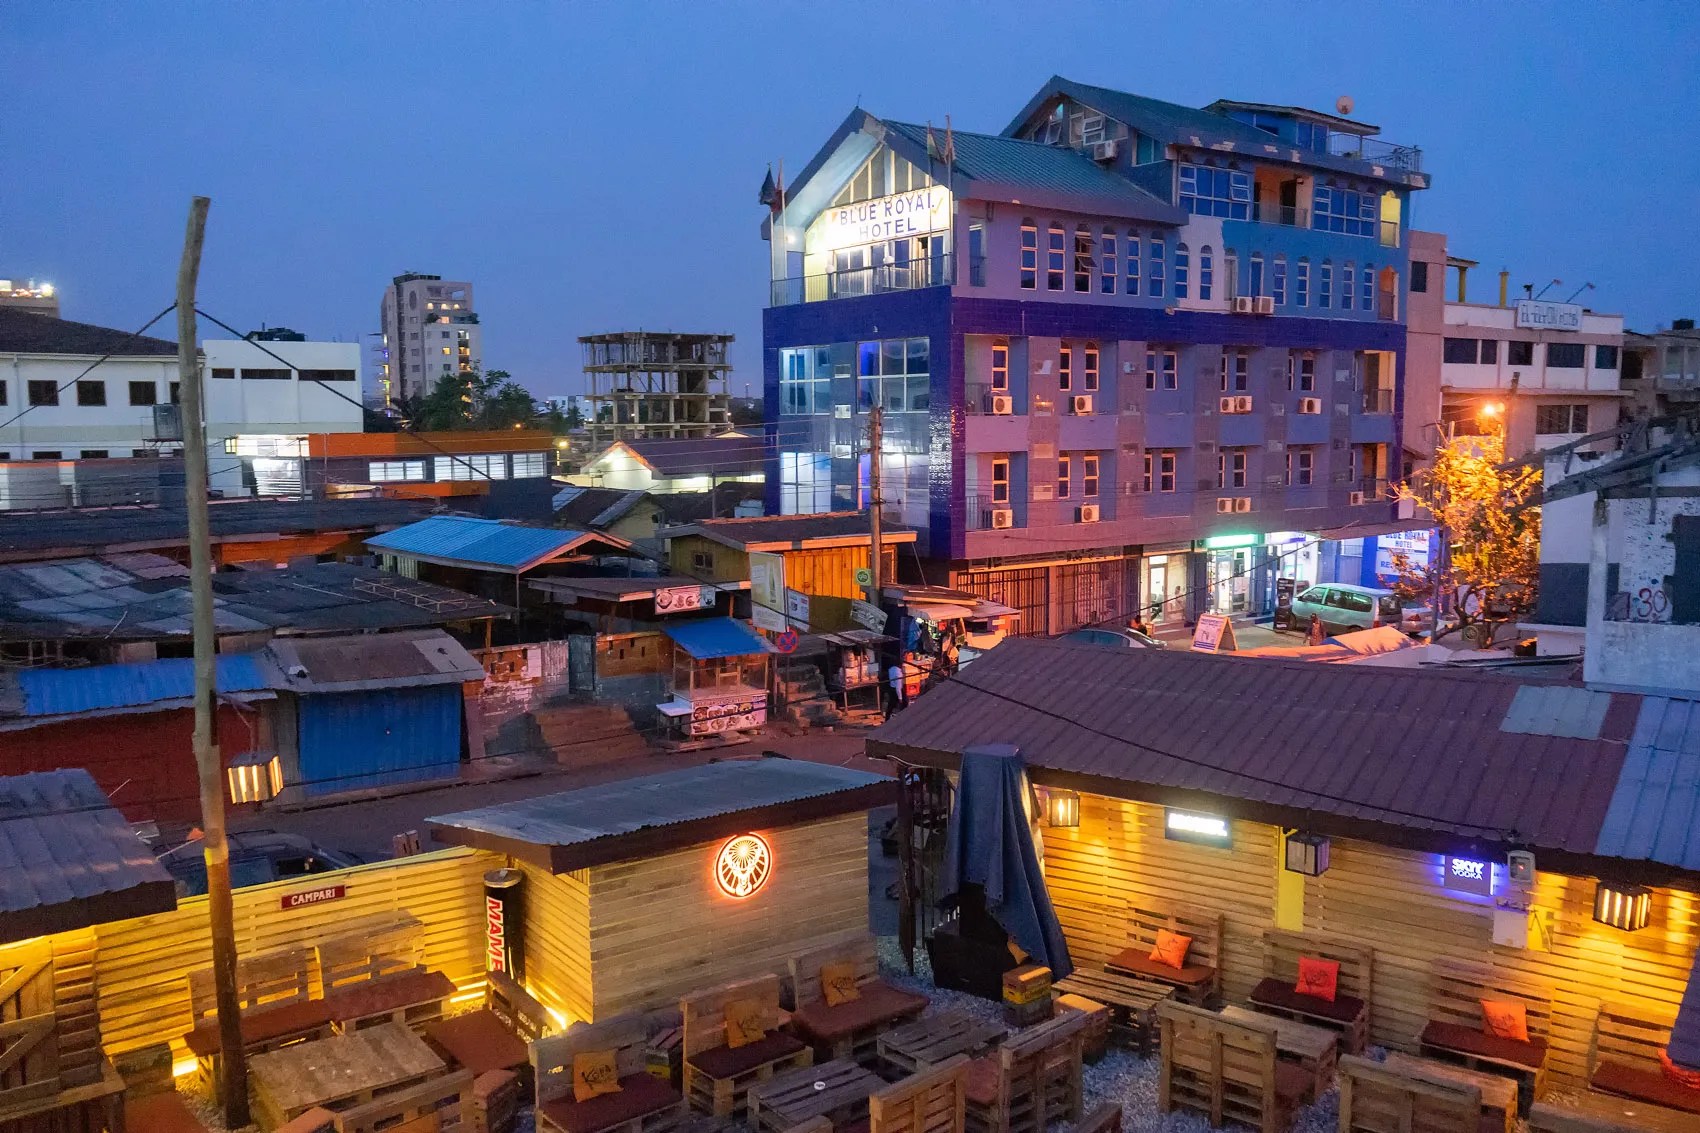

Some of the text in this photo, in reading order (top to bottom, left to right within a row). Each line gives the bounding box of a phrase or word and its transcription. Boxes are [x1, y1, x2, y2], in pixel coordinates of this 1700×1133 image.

[840, 192, 935, 226] BLUE ROYAL
[859, 217, 917, 239] HOTEL
[1451, 868, 1483, 881] VODKA
[291, 888, 336, 906] CAMPARI
